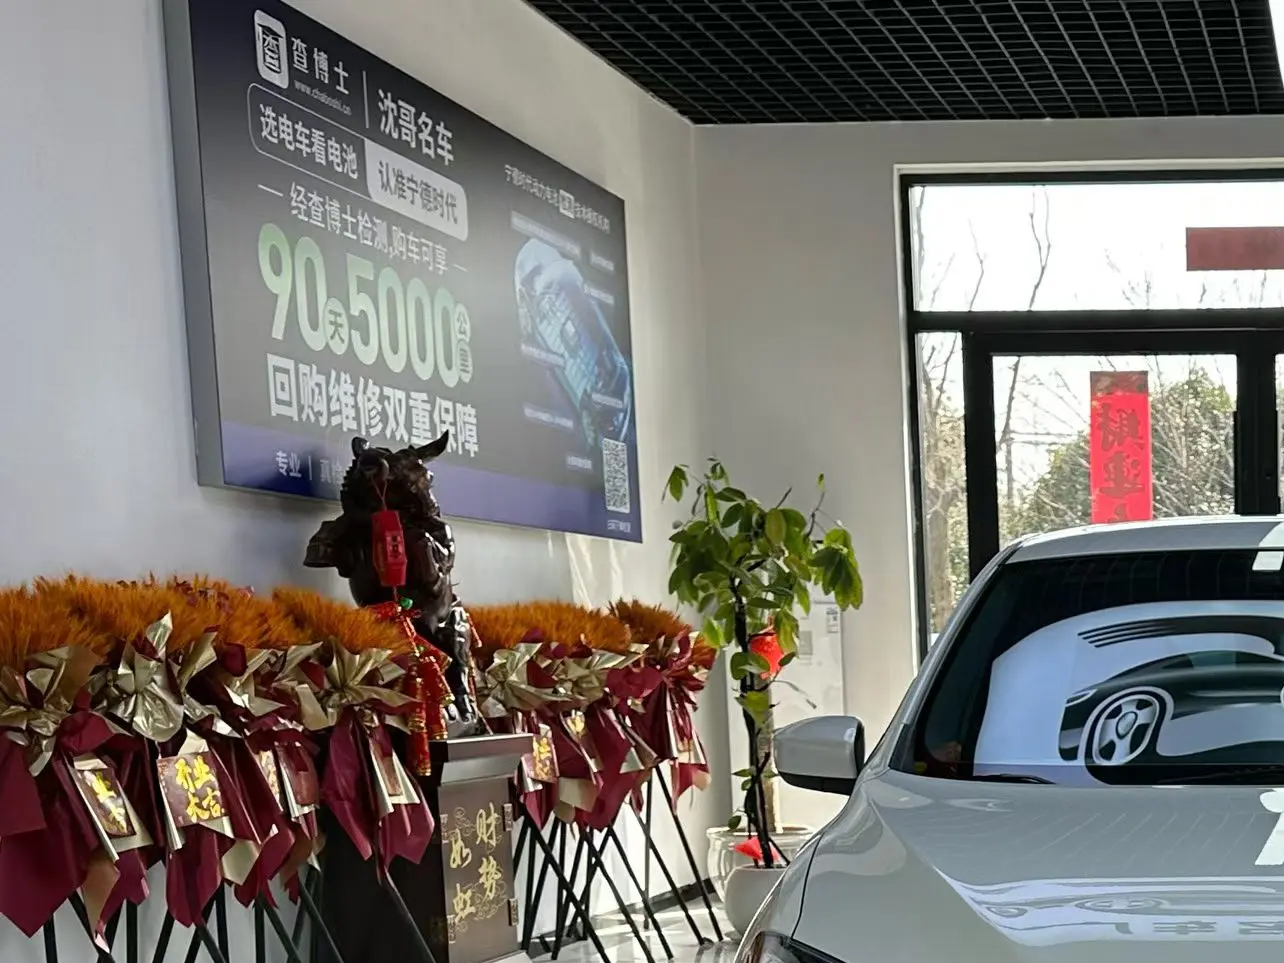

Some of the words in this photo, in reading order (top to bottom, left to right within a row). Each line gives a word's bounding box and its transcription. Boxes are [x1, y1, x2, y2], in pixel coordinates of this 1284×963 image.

[291, 37, 349, 94] 查博士
[259, 103, 358, 179] 选电车看电池
[378, 88, 454, 165] 沈哥名车
[378, 160, 458, 225] 认准宁德时代
[266, 352, 480, 457] 回购维修双重保障
[275, 450, 302, 478] 专业
